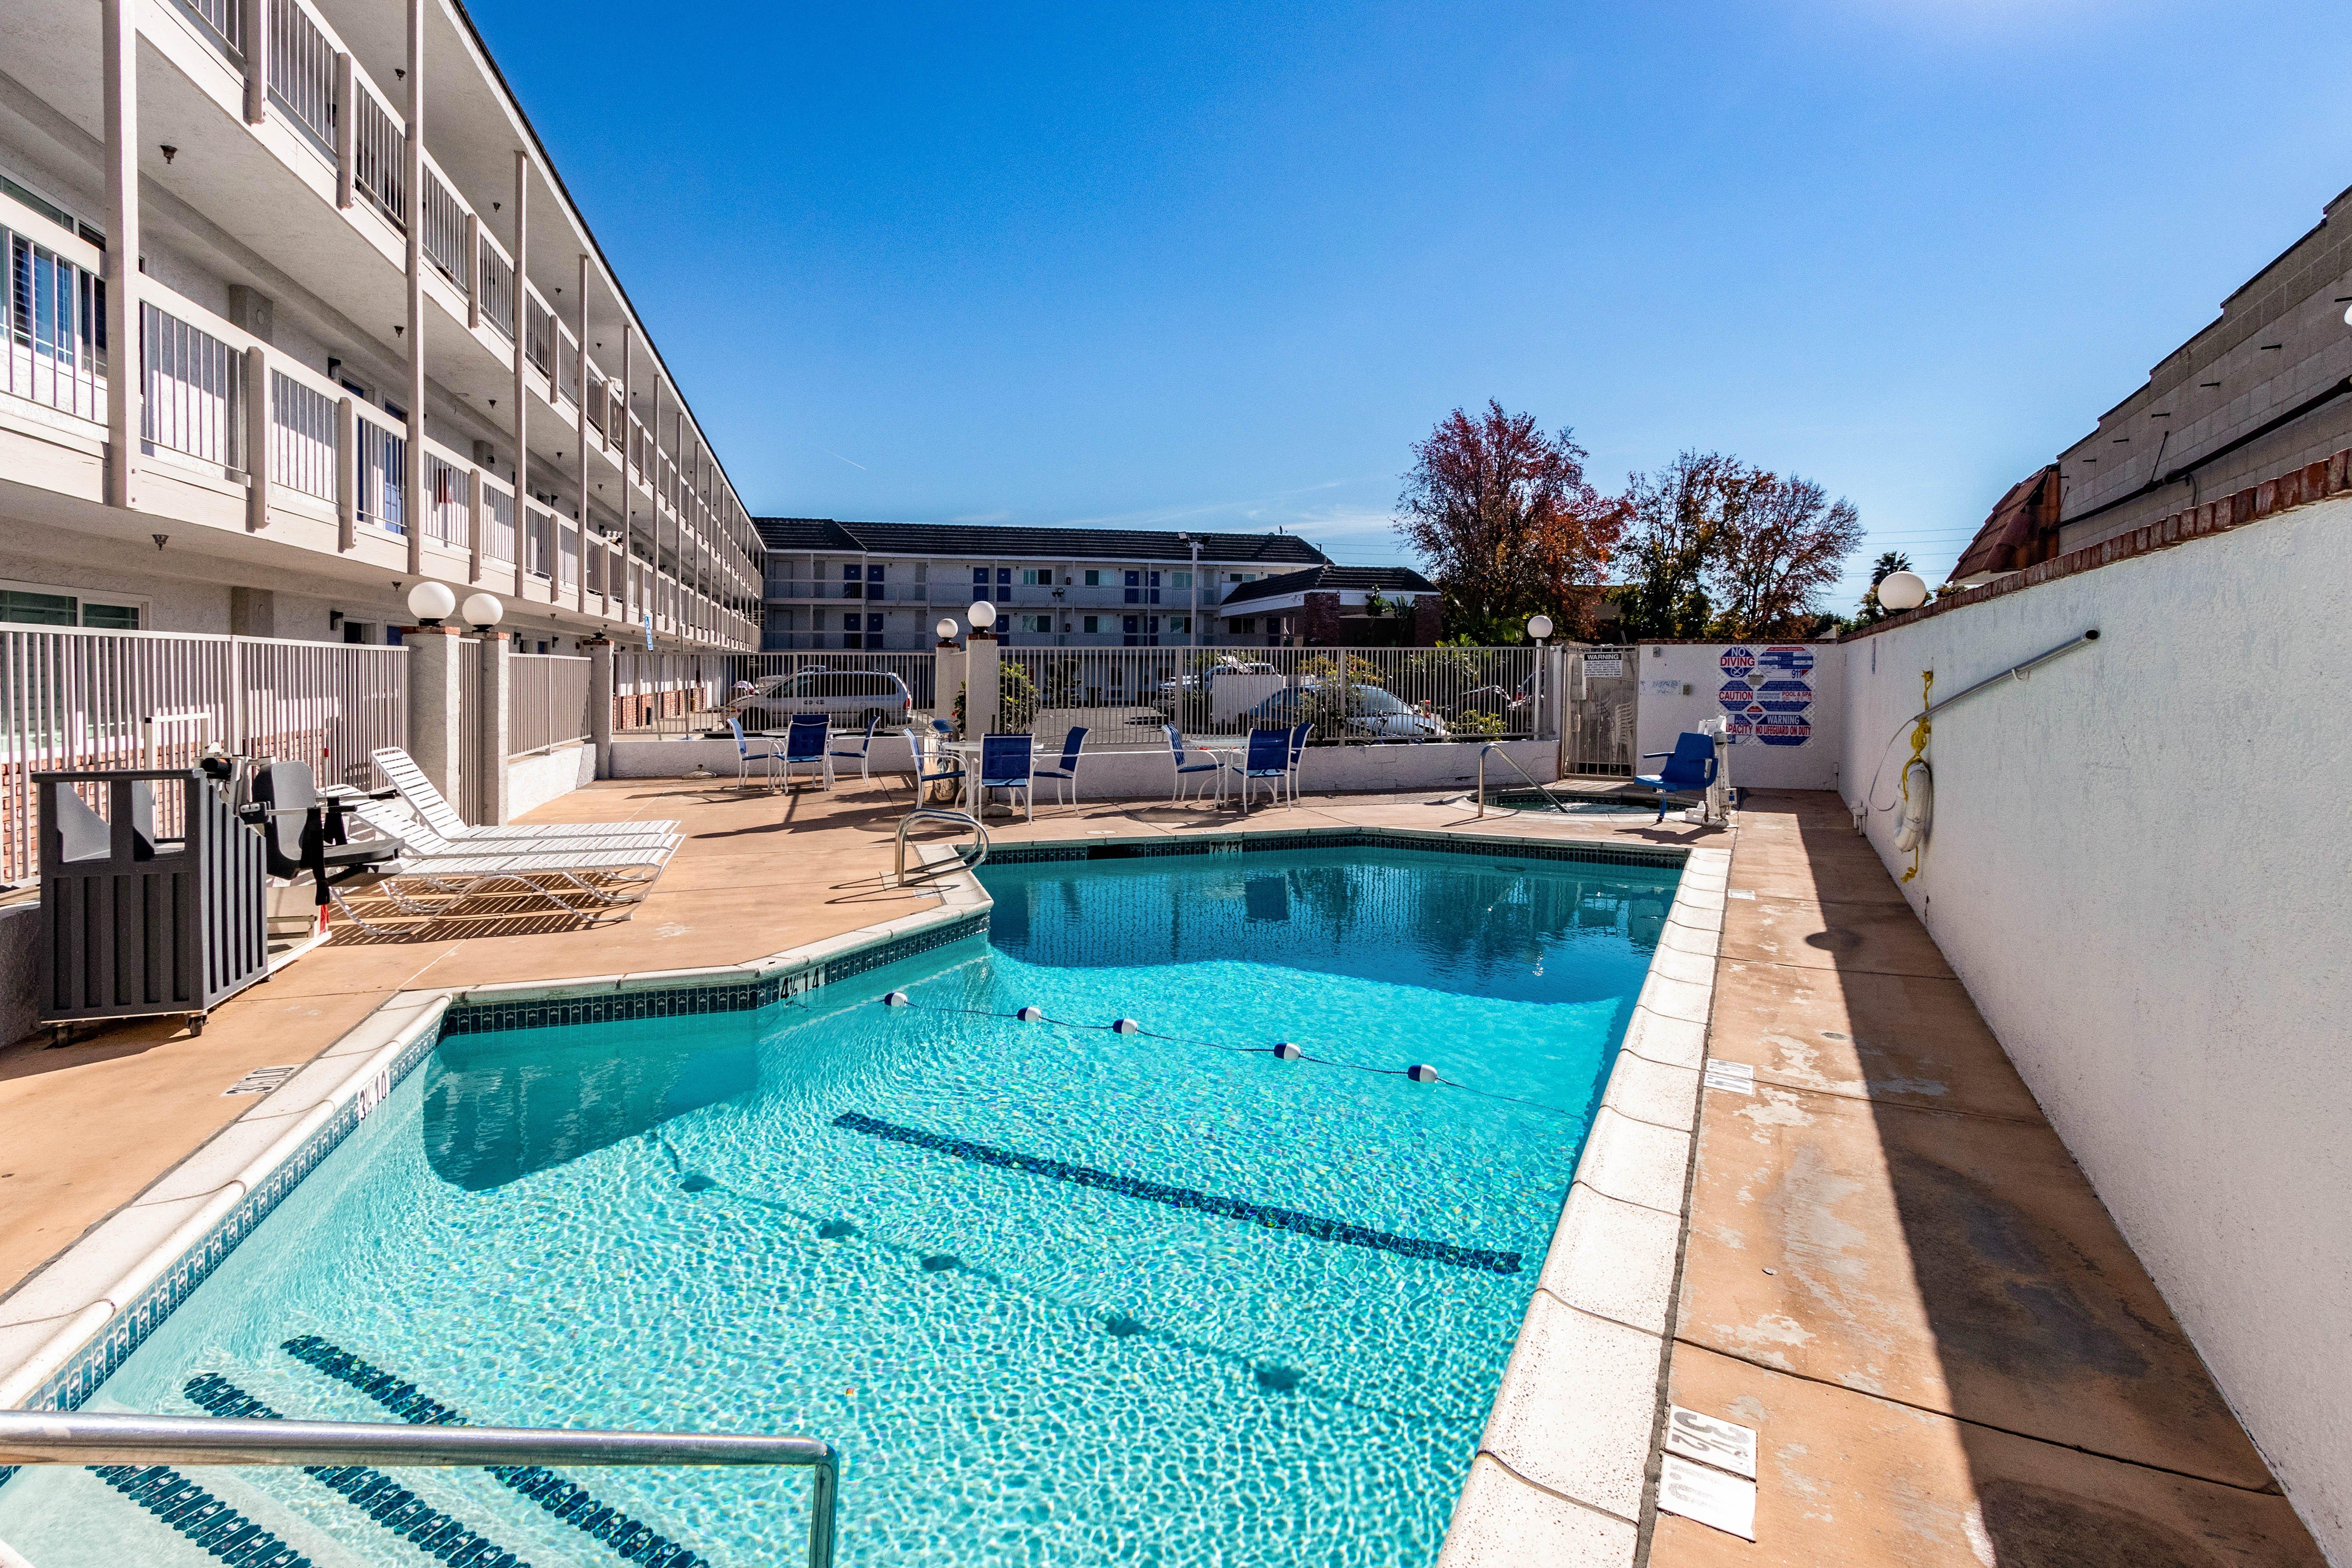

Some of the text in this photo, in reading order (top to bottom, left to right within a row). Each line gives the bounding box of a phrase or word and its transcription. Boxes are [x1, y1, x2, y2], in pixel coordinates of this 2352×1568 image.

[1731, 647, 1745, 656] NO
[1720, 657, 1755, 666] DIVING
[1792, 669, 1801, 678] 911
[1719, 691, 1753, 700] CAUTION
[1767, 715, 1799, 724] WARNING
[1756, 725, 1811, 735] NO LIFEGUARD ON DUTY
